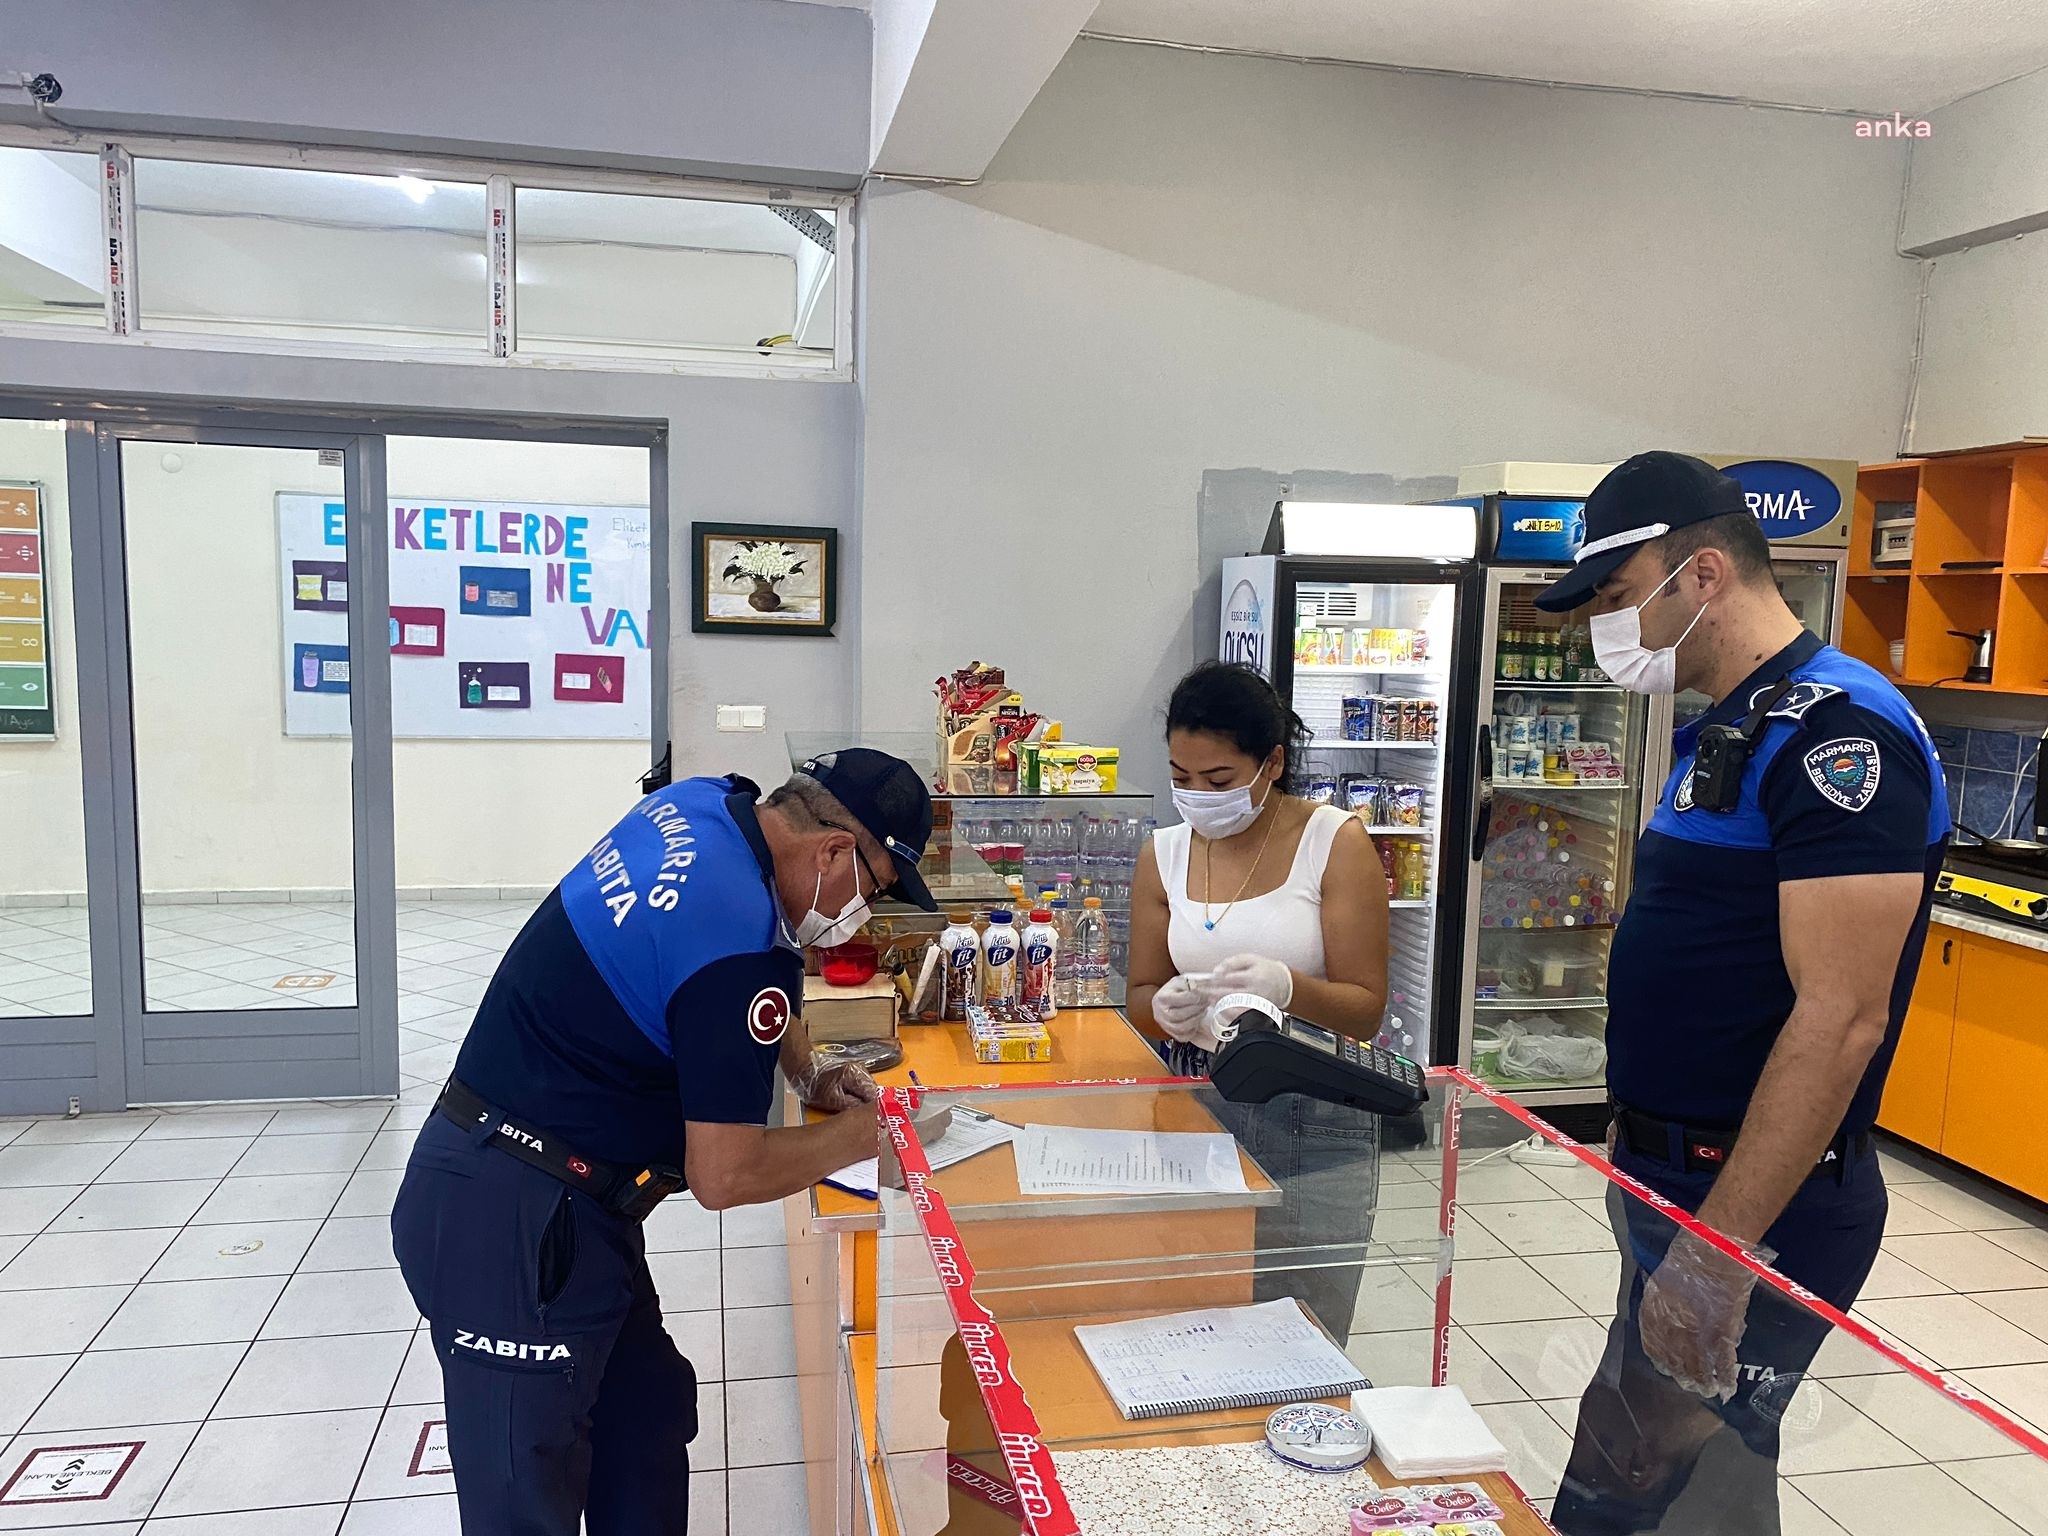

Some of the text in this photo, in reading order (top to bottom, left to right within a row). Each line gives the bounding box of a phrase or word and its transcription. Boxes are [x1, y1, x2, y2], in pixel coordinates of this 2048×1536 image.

[546, 561, 592, 604] NE
[1808, 741, 1872, 766] MARMARİS
[1811, 767, 1853, 806] BELEDİYE
[1855, 754, 1878, 803] ZABITASI
[956, 948, 973, 967] fit
[991, 947, 1010, 965] fit
[1030, 946, 1048, 964] fit
[453, 1327, 572, 1362] ZABITA
[959, 1318, 1004, 1388] ÜLKER
[59, 1469, 113, 1479] BEKLEME
[999, 1430, 1053, 1519] ÜLKER
